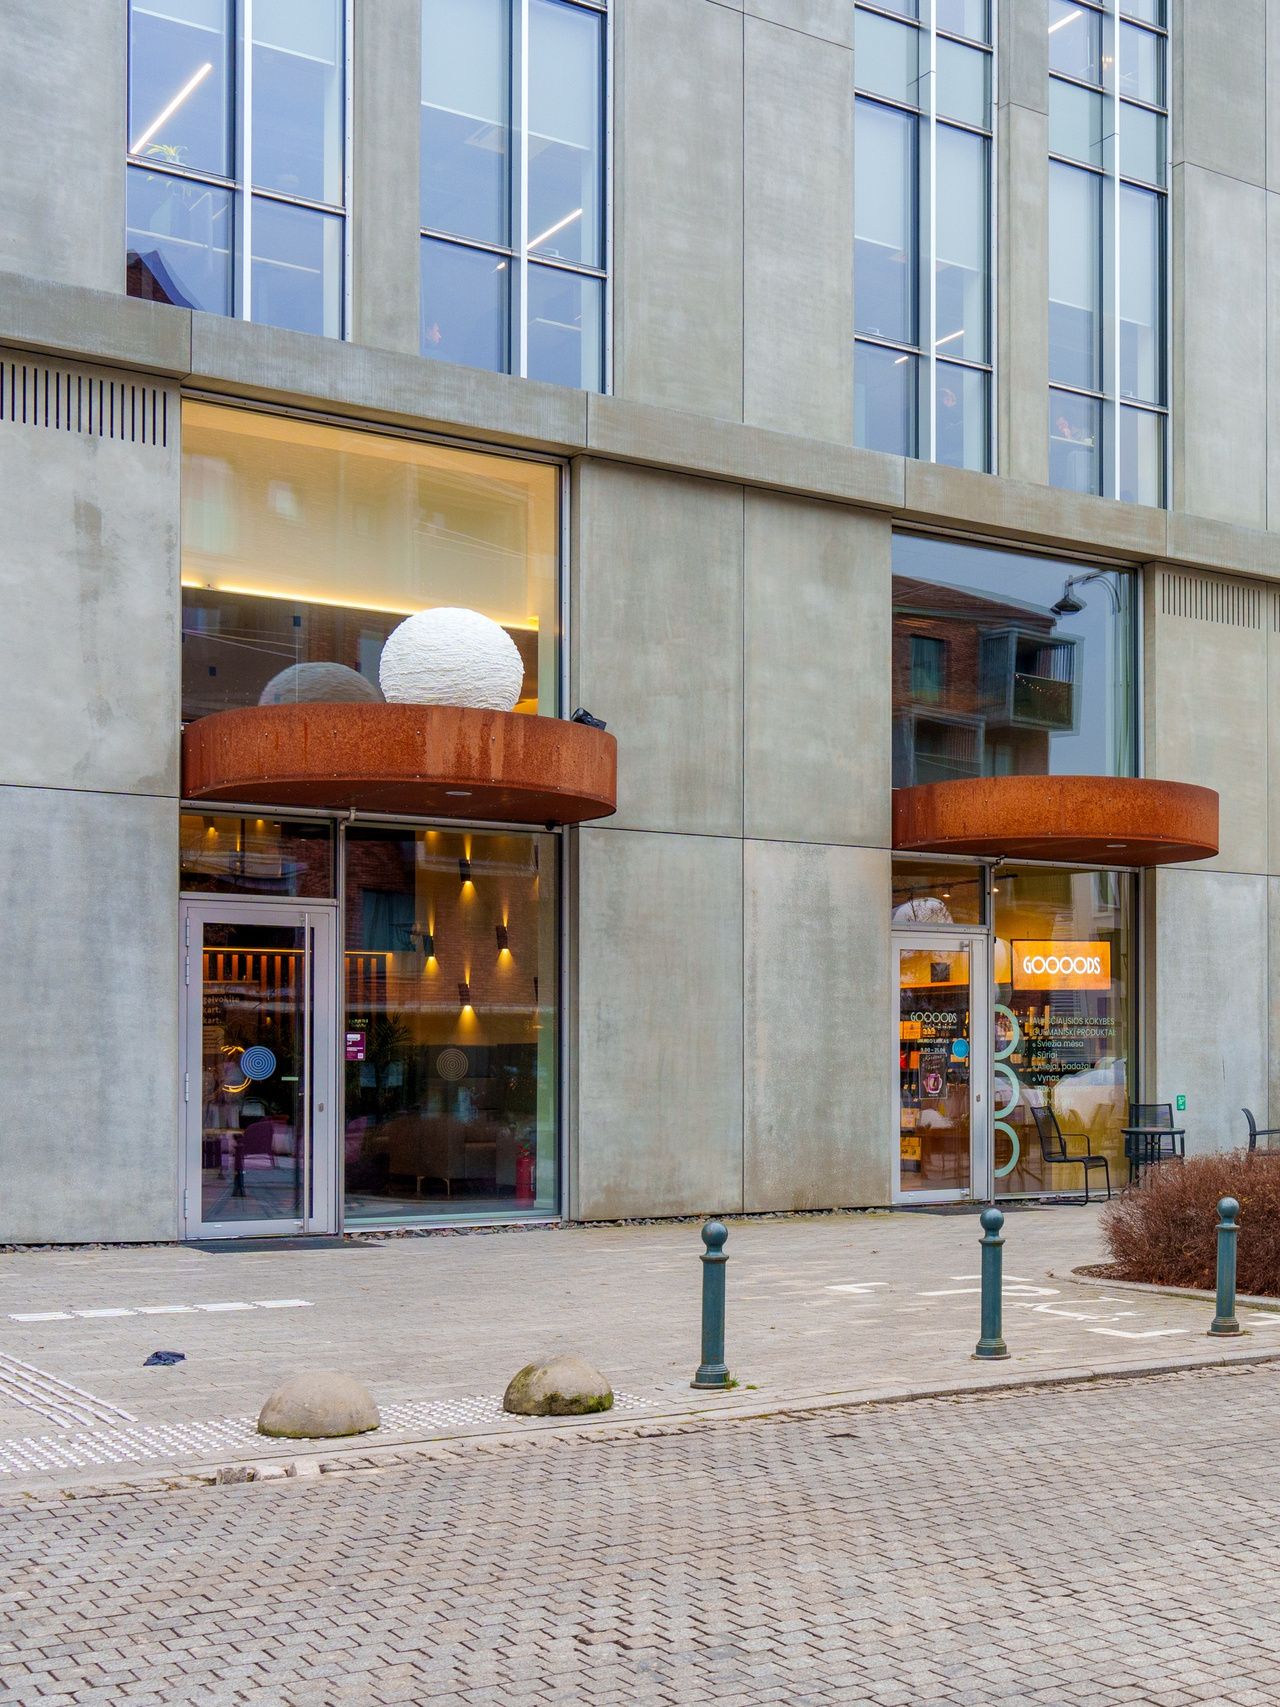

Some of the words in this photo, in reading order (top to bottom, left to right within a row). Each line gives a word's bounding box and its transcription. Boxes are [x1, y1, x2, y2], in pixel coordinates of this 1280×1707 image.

[1023, 956, 1101, 974] GOOOODS
[910, 1011, 957, 1023] GOOOODS
[1037, 1074, 1060, 1084] Vynas
